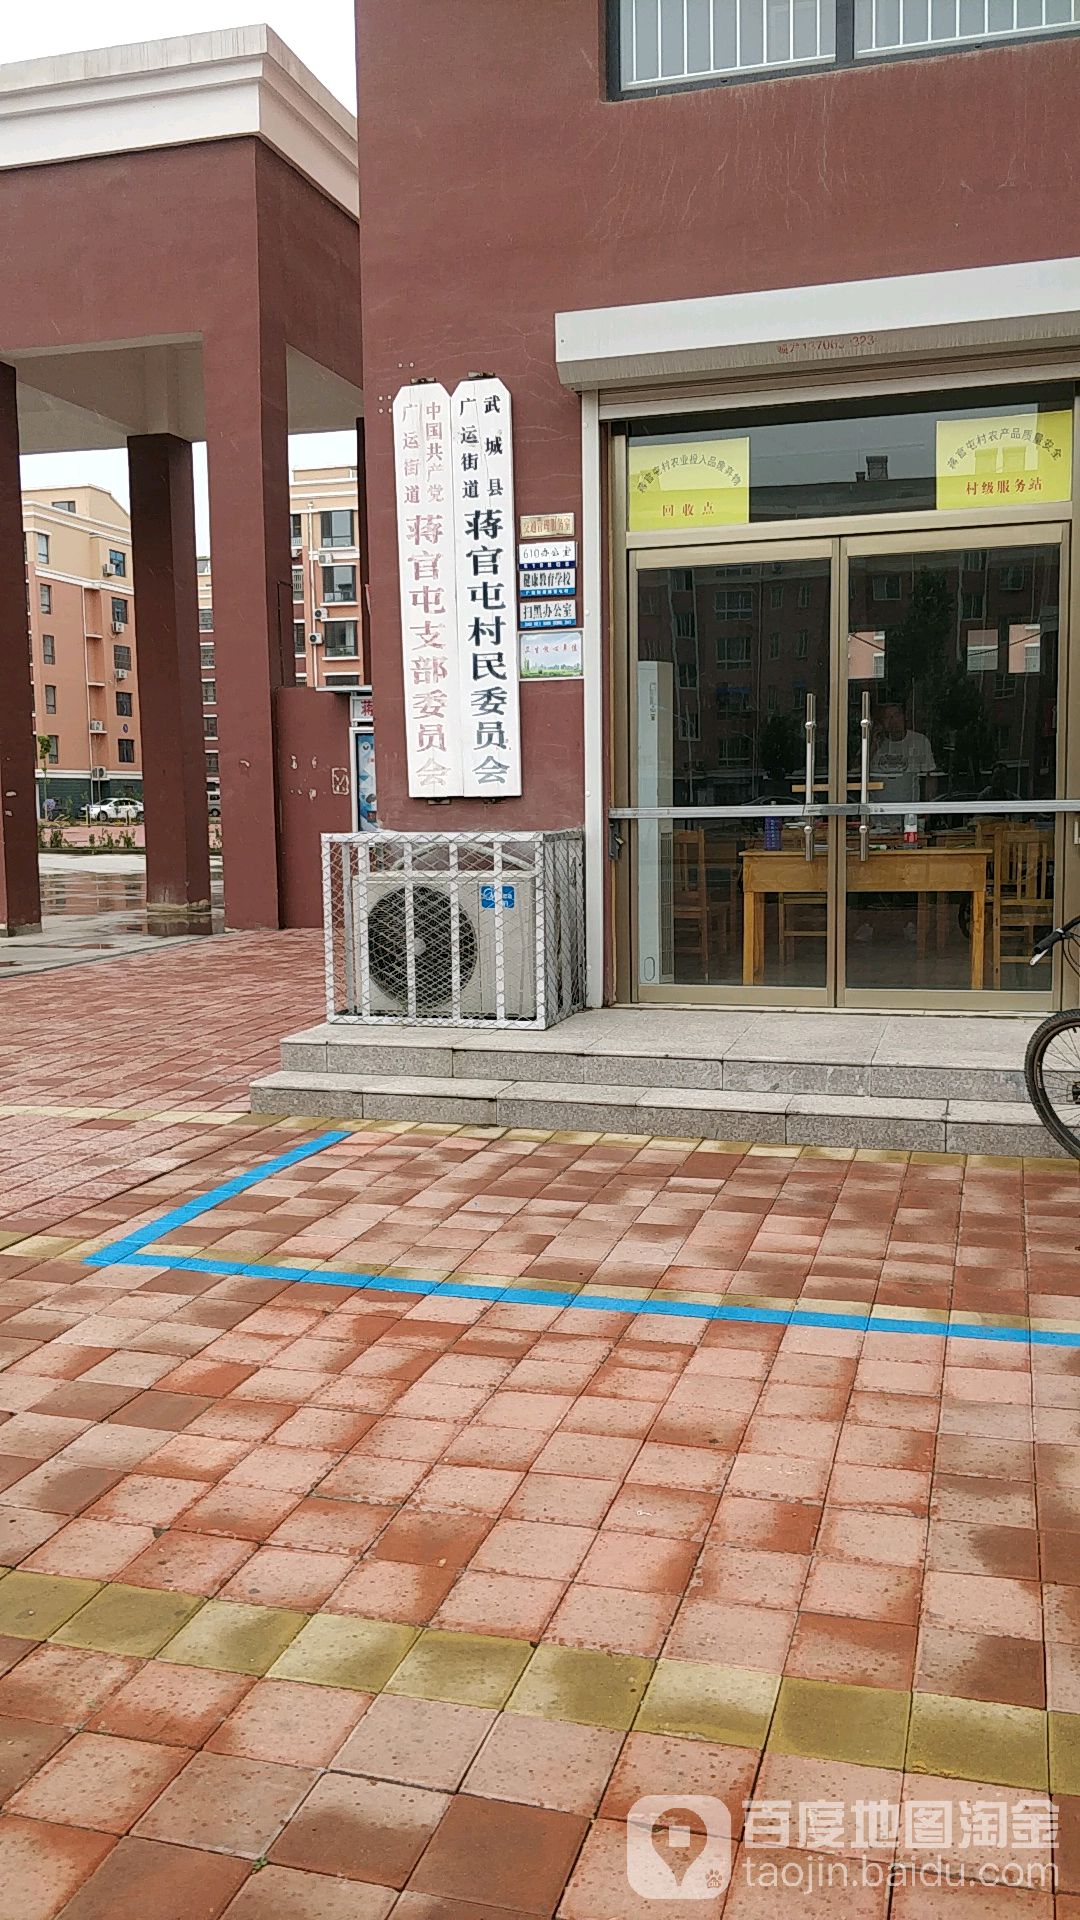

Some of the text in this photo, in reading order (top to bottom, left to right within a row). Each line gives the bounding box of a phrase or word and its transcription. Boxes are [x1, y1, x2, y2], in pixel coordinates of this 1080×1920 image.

[402, 403, 420, 504] 广运街道
[426, 401, 444, 502] 中国共产党
[459, 397, 479, 499] 广运街道
[484, 394, 504, 497] 武城县
[966, 477, 1042, 496] 村级服务站
[662, 501, 714, 517] 回收点
[523, 602, 572, 620] 扫黑办公室
[524, 571, 571, 588] 健康教育学校
[406, 514, 451, 786] 蒋官屯支部委员会
[464, 509, 510, 784] 蒋官屯村民委员会
